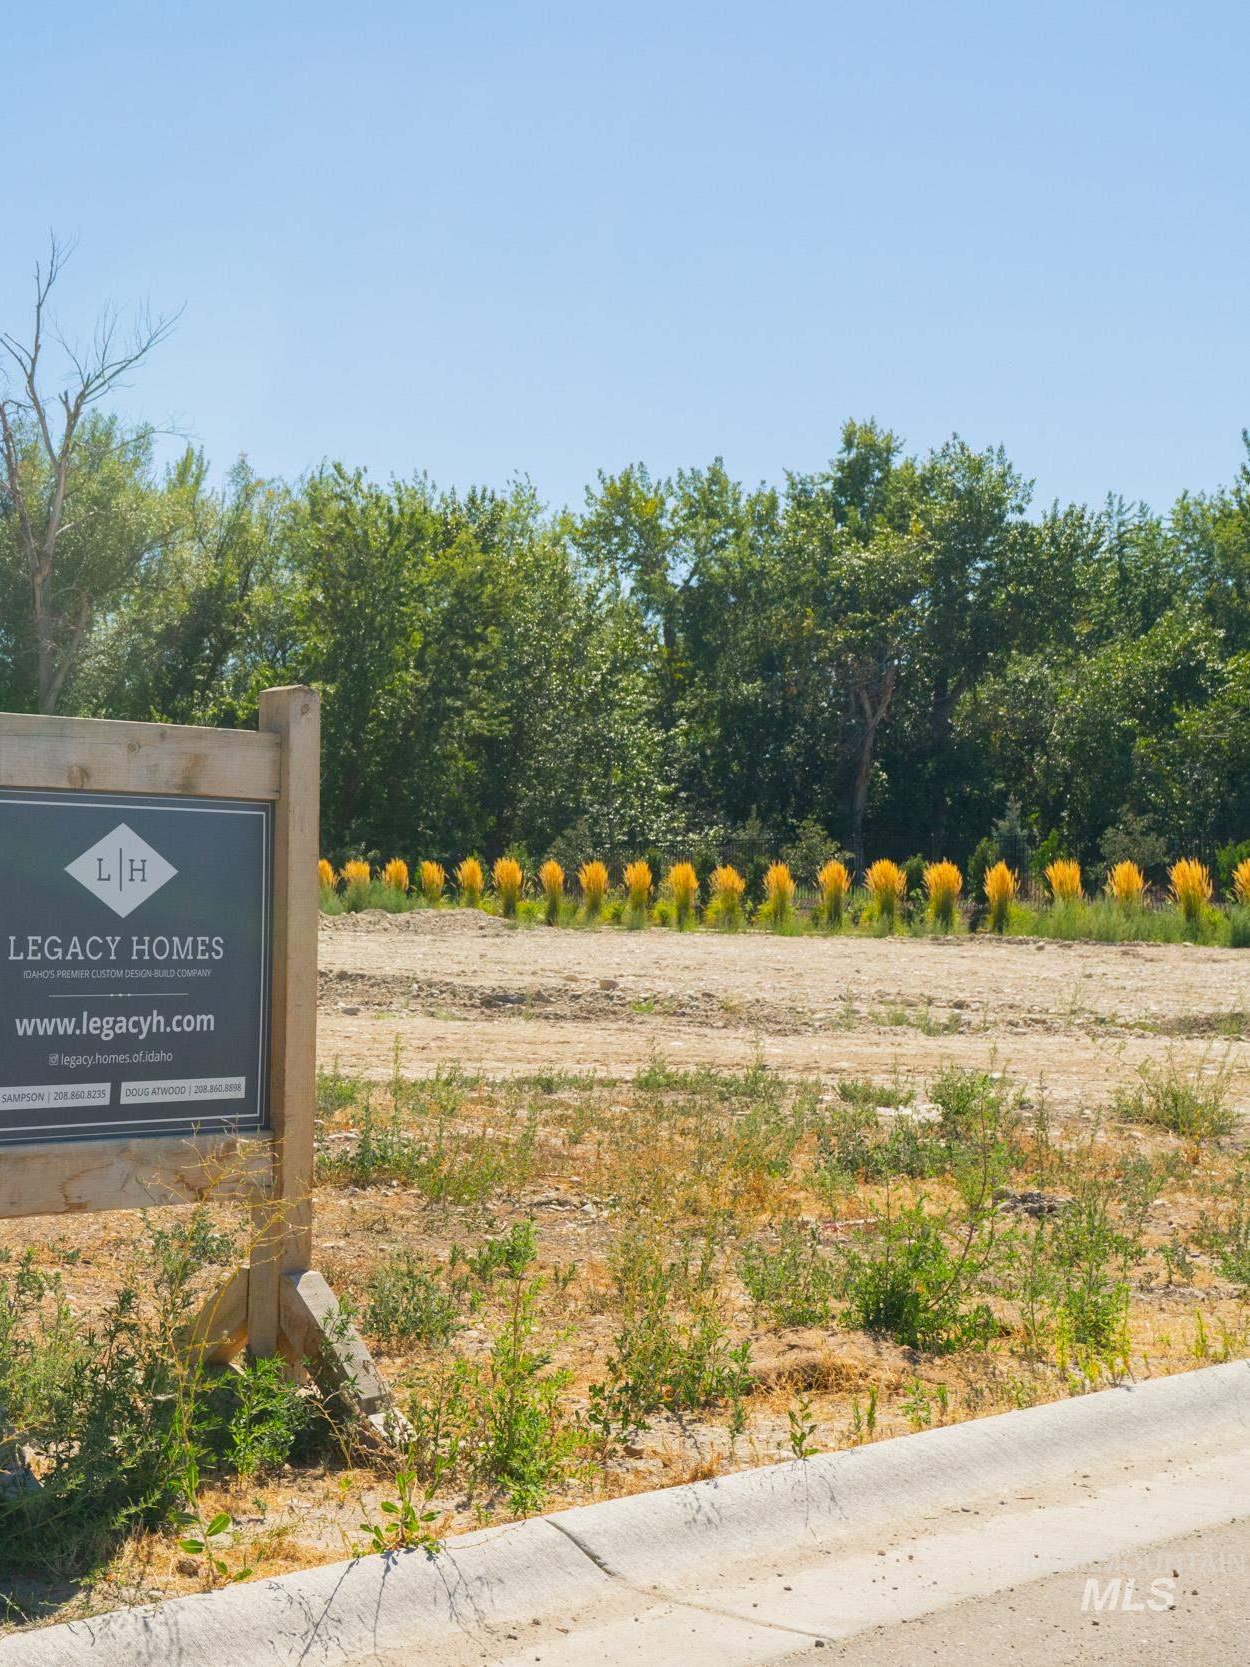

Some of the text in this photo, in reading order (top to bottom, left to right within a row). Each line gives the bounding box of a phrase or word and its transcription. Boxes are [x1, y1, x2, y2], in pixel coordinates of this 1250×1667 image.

[8, 936, 224, 961] LEGACY HOMES
[23, 968, 212, 979] IDAHO'S PREMIER CUSTOM DESIGN-BUILD COMPANY
[15, 1010, 215, 1041] www.legacyh.com
[61, 1050, 173, 1068] legacy.homes.of.idaho
[1, 1093, 45, 1103] SAMPSON
[53, 1089, 106, 1101] 208.860.8235
[125, 1088, 150, 1097] DOUG
[151, 1086, 187, 1096] ATWOOD
